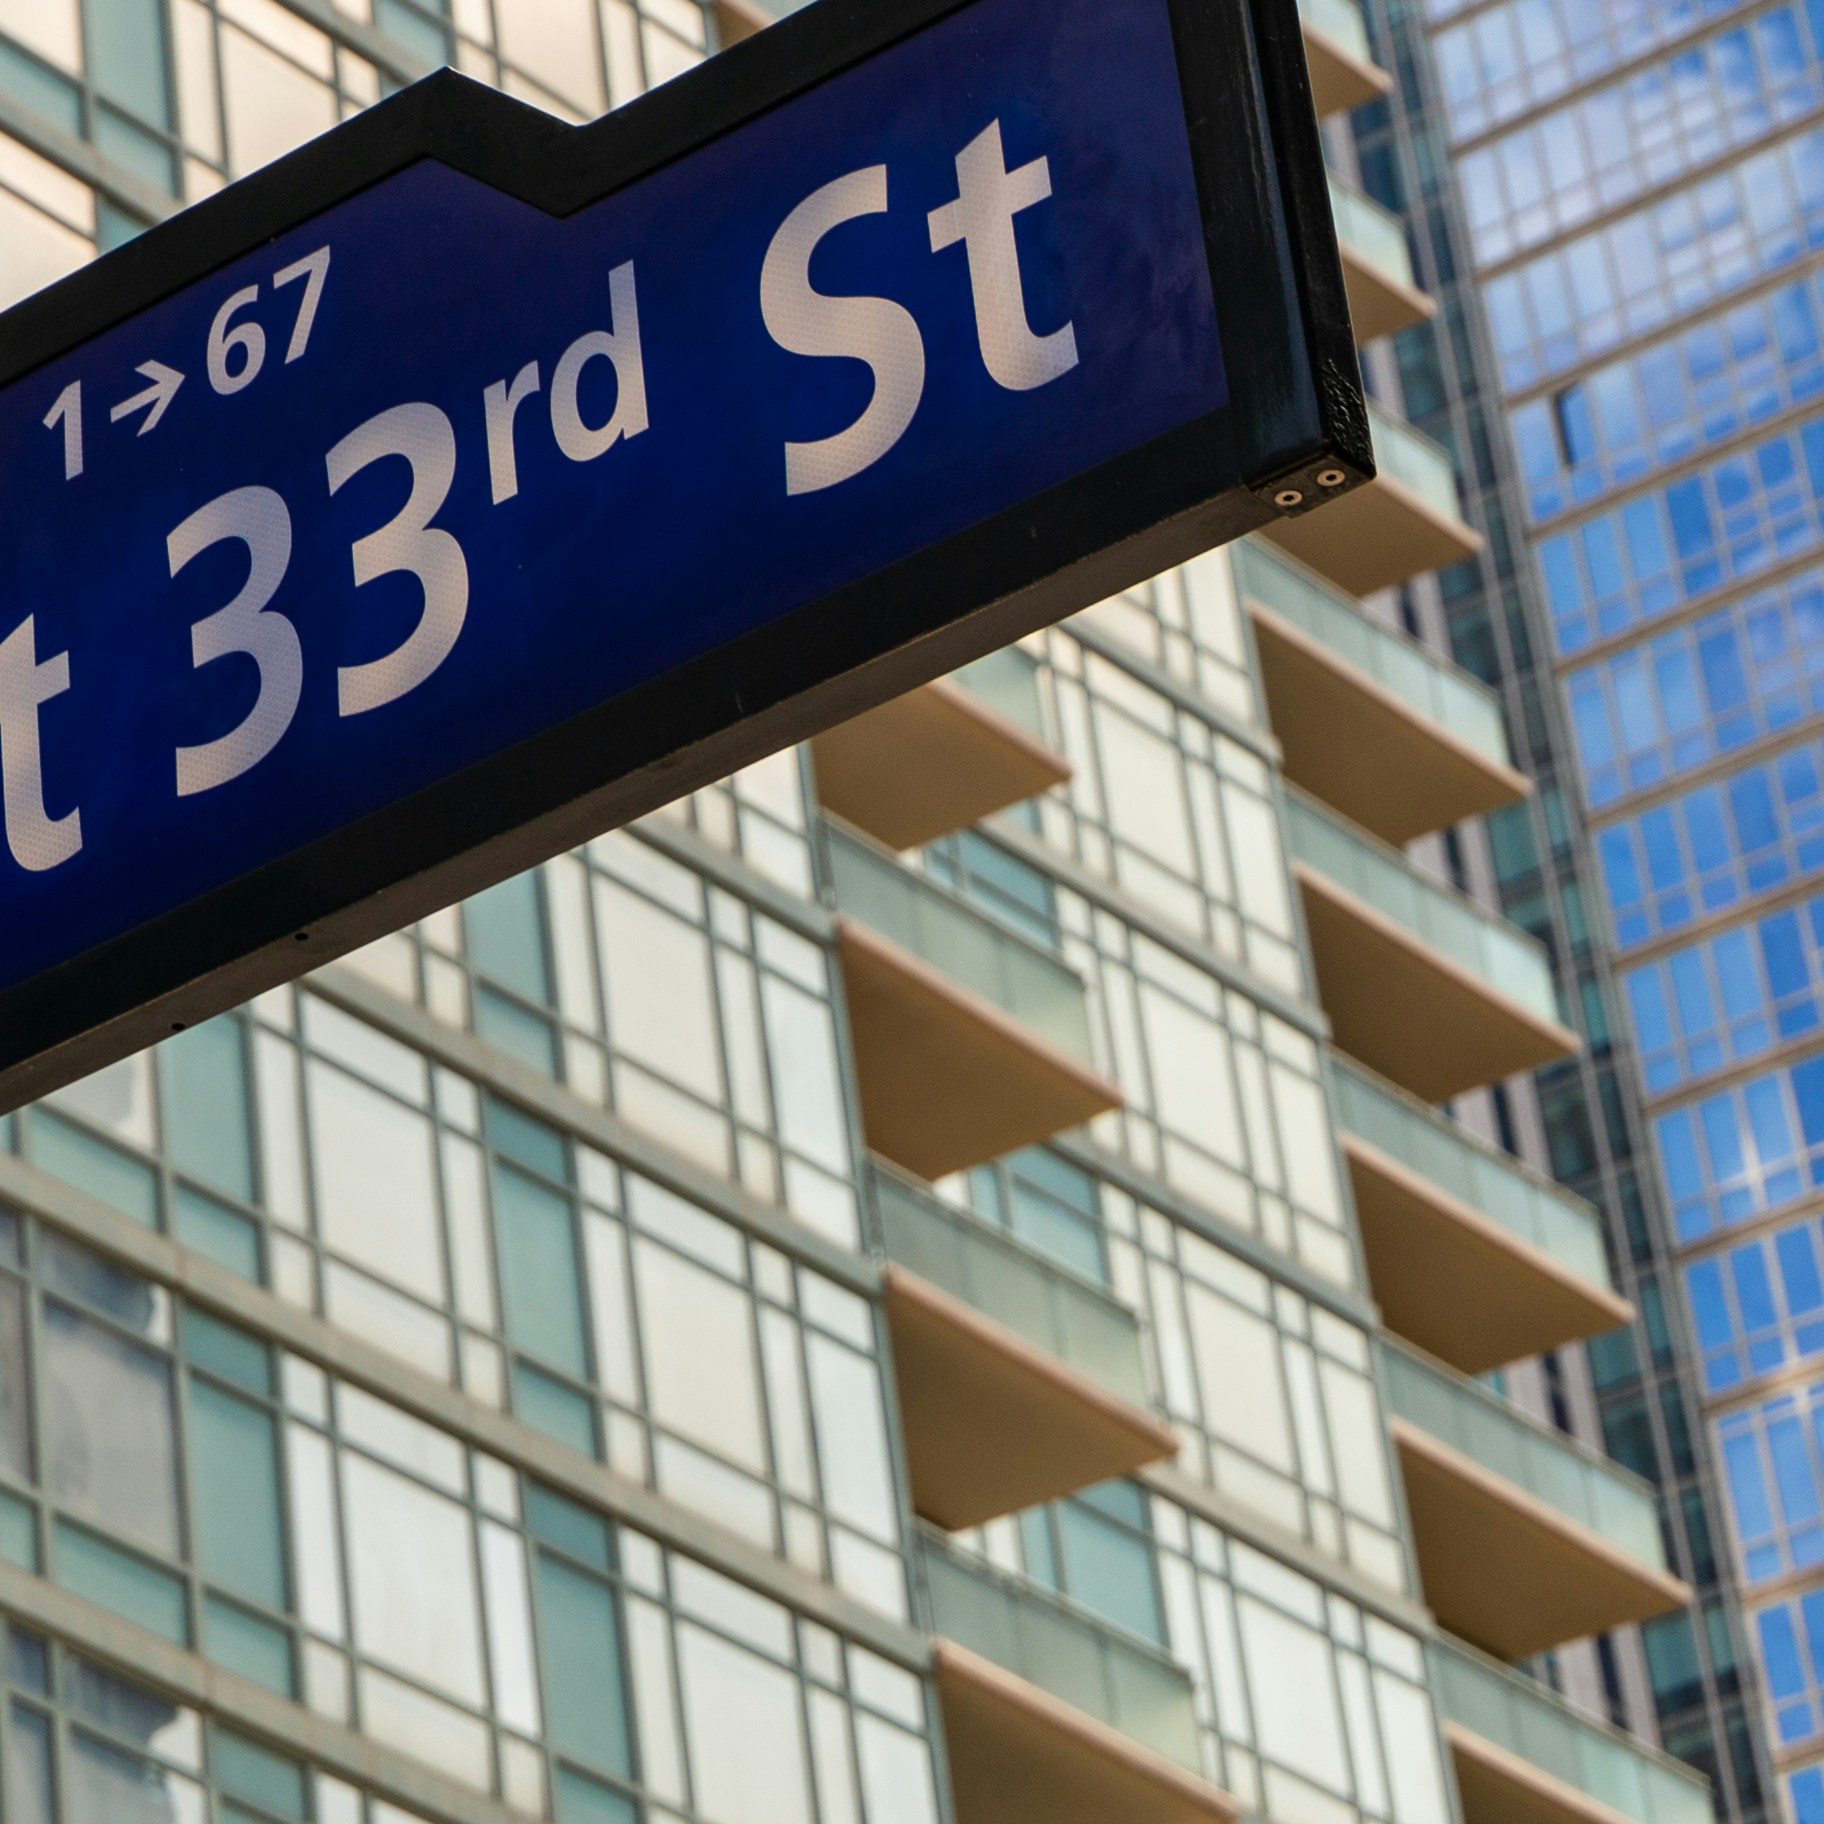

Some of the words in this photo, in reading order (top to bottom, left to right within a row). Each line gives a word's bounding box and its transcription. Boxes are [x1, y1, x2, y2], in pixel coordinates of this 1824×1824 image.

[42, 378, 85, 482] 1
[206, 243, 331, 396] 67
[165, 257, 650, 798] 33rd
[759, 116, 1080, 497] St
